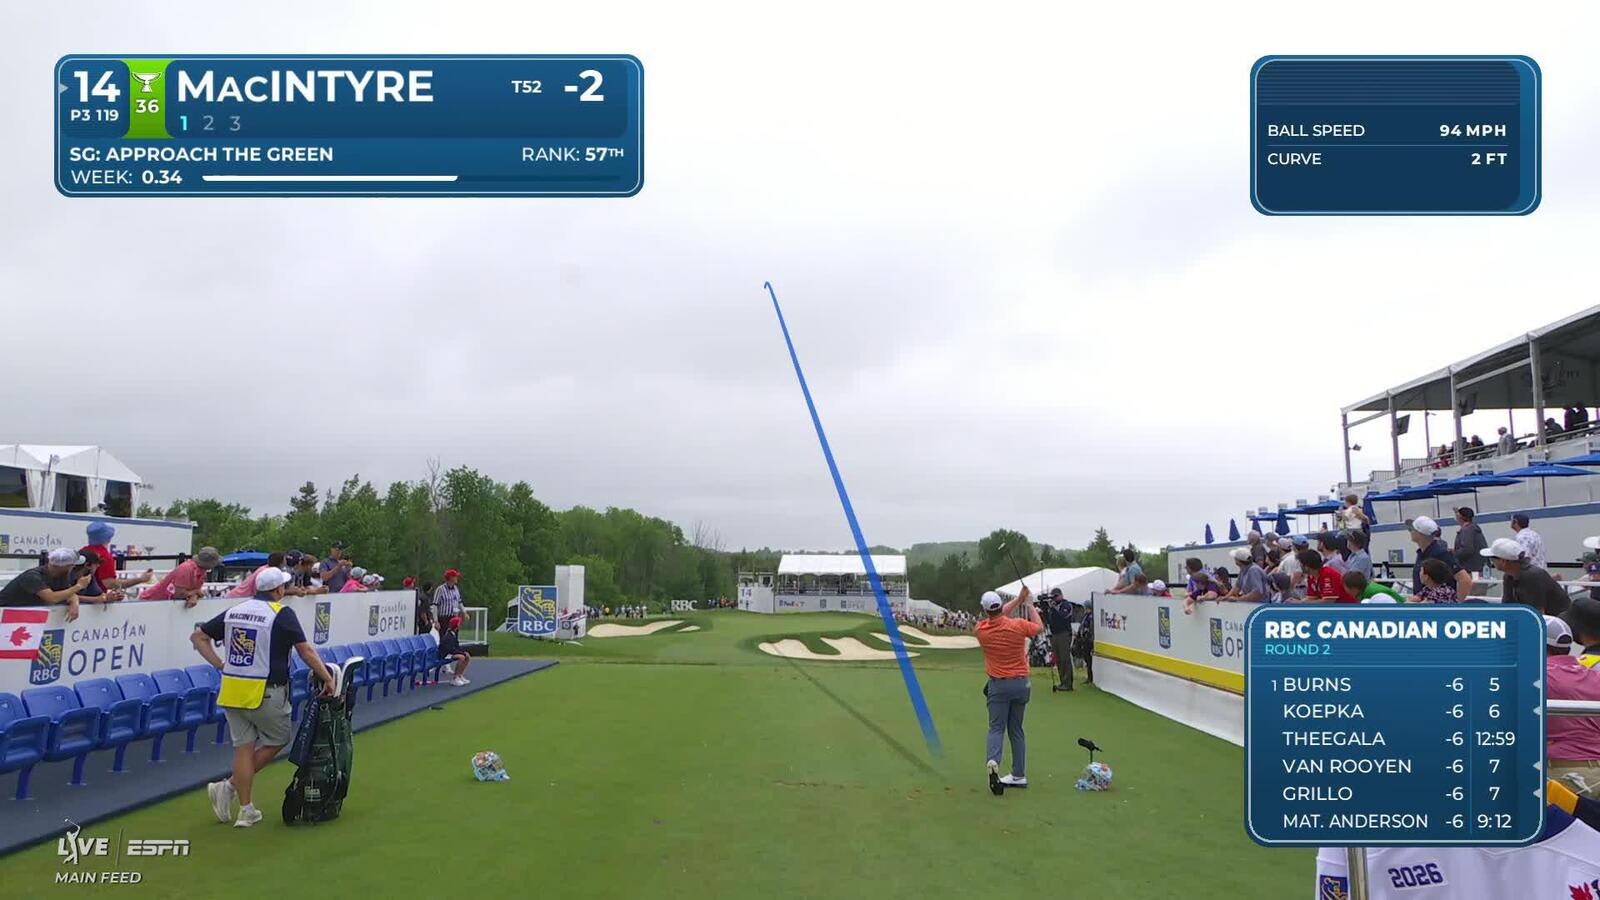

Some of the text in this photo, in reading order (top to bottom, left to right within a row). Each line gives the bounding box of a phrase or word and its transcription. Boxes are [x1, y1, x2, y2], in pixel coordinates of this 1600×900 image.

[671, 599, 697, 611] RBC
[229, 613, 267, 624] MACINTYRE
[380, 615, 406, 633] OPEN
[522, 619, 554, 632] RBC
[72, 618, 146, 643] CANADIAN
[68, 643, 145, 676] OPEN
[230, 654, 252, 665] RBC
[33, 666, 59, 682] RBC
[1388, 862, 1444, 888] 2026
